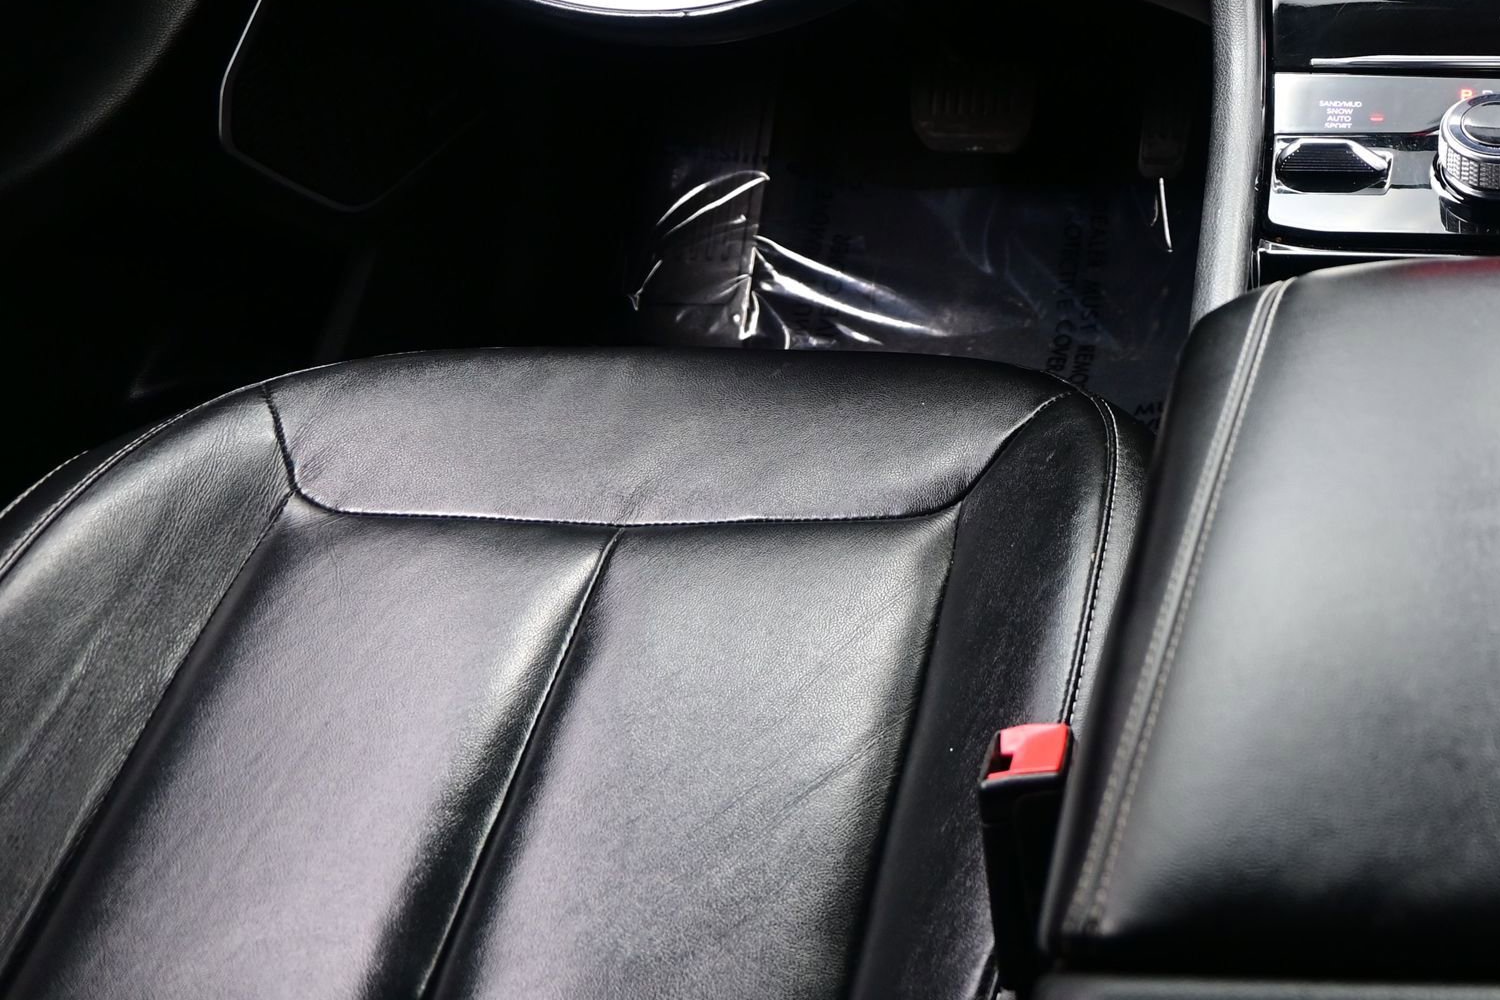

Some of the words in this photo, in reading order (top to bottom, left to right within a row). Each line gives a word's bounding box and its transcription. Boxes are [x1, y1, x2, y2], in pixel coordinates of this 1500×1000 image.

[1319, 100, 1362, 108] SAND/MUD
[1326, 107, 1354, 115] SNOW
[1046, 320, 1073, 372] COVER
